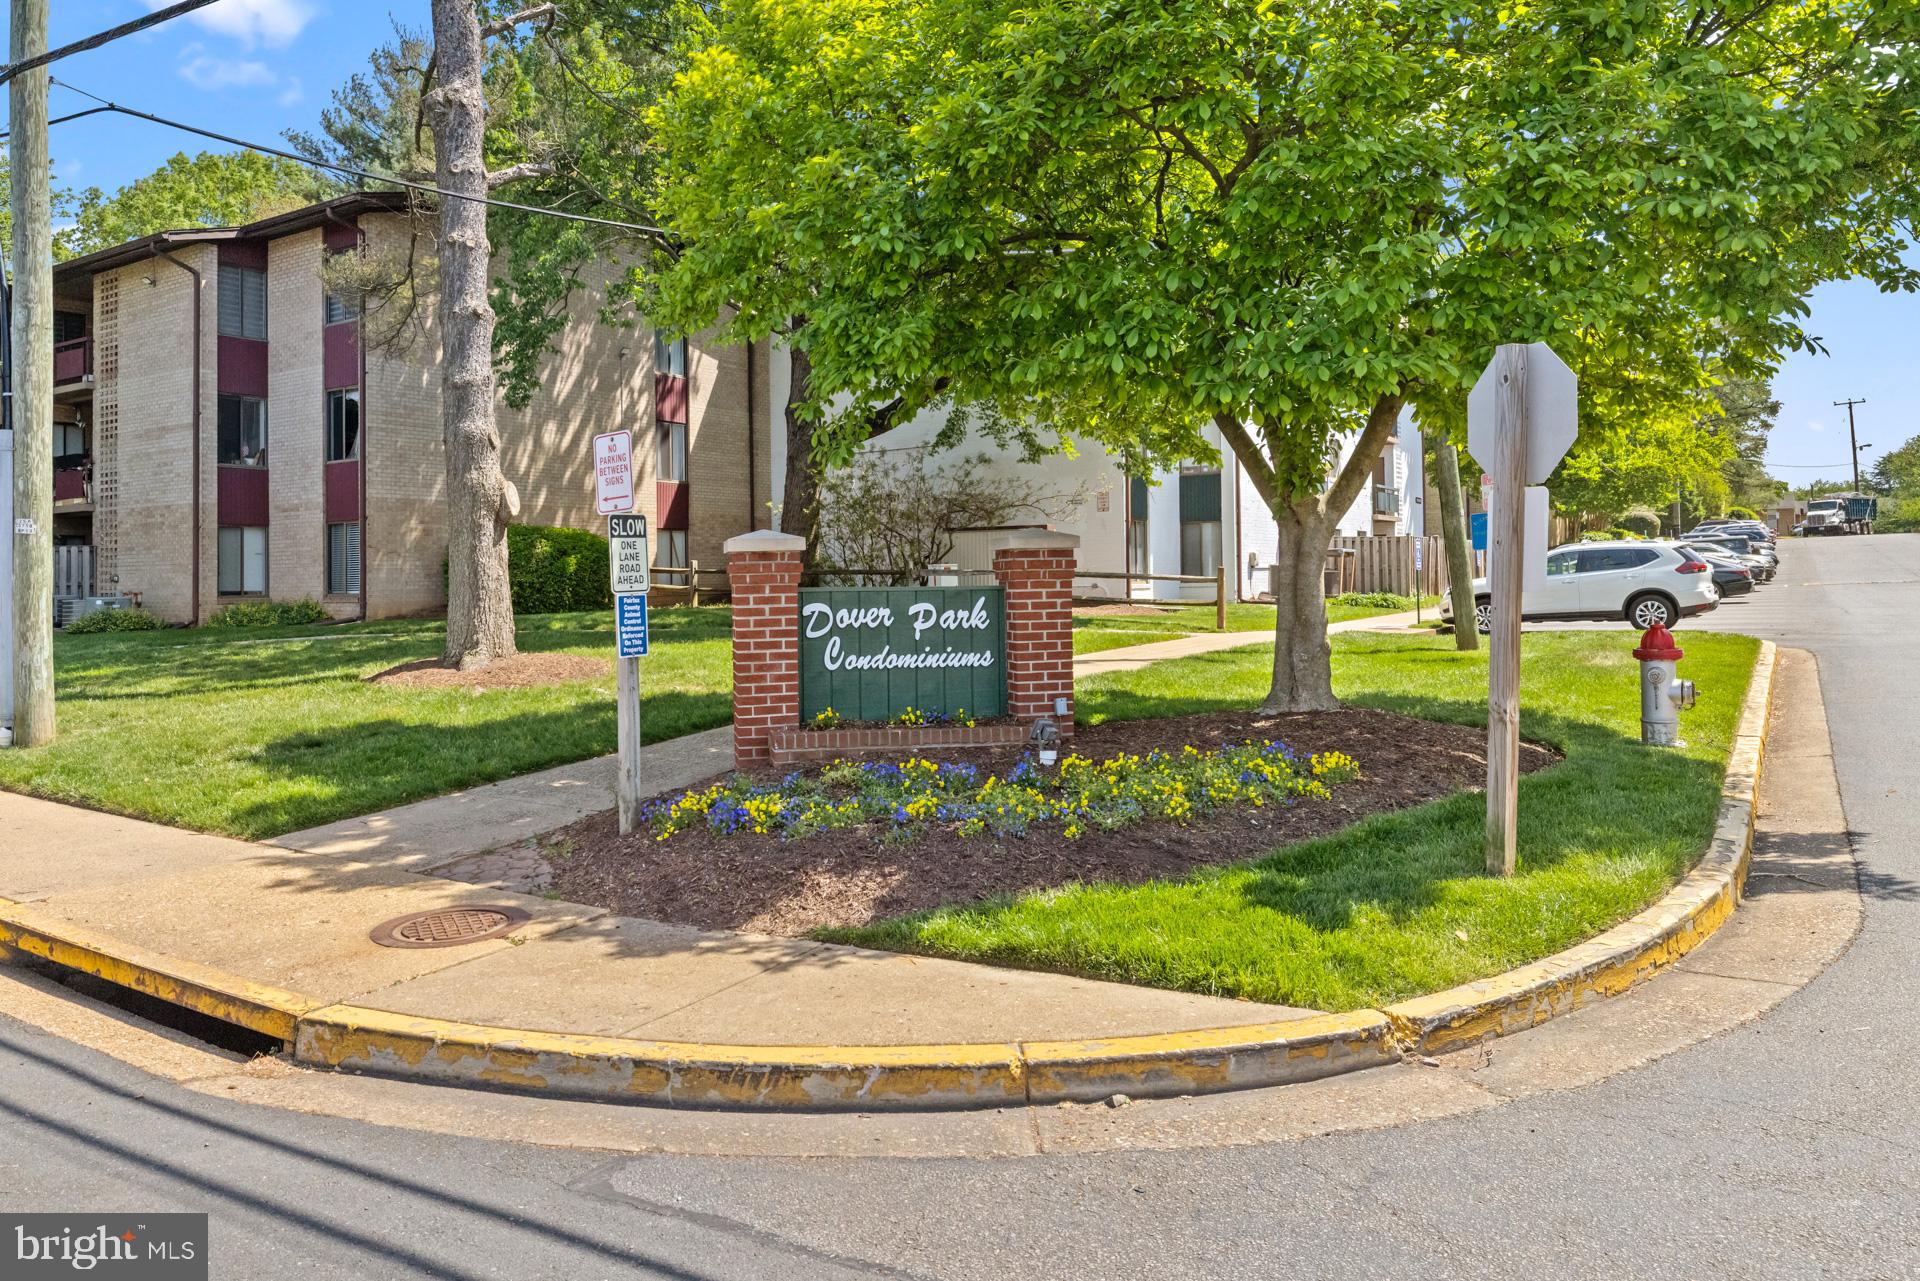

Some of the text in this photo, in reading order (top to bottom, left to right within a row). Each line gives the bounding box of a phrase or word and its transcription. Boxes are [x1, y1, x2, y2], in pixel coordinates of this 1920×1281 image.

[608, 444, 617, 453] NO
[600, 453, 627, 465] PARKING
[600, 463, 629, 477] BETWEEN
[605, 475, 624, 486] SIGNS
[611, 518, 645, 536] SLOW
[621, 540, 637, 550] ONE
[619, 552, 640, 561] LANE
[620, 564, 640, 573] ROAD
[618, 575, 645, 584] AHEAD
[802, 596, 990, 641] Dover Park
[824, 635, 995, 671] Condominiums
